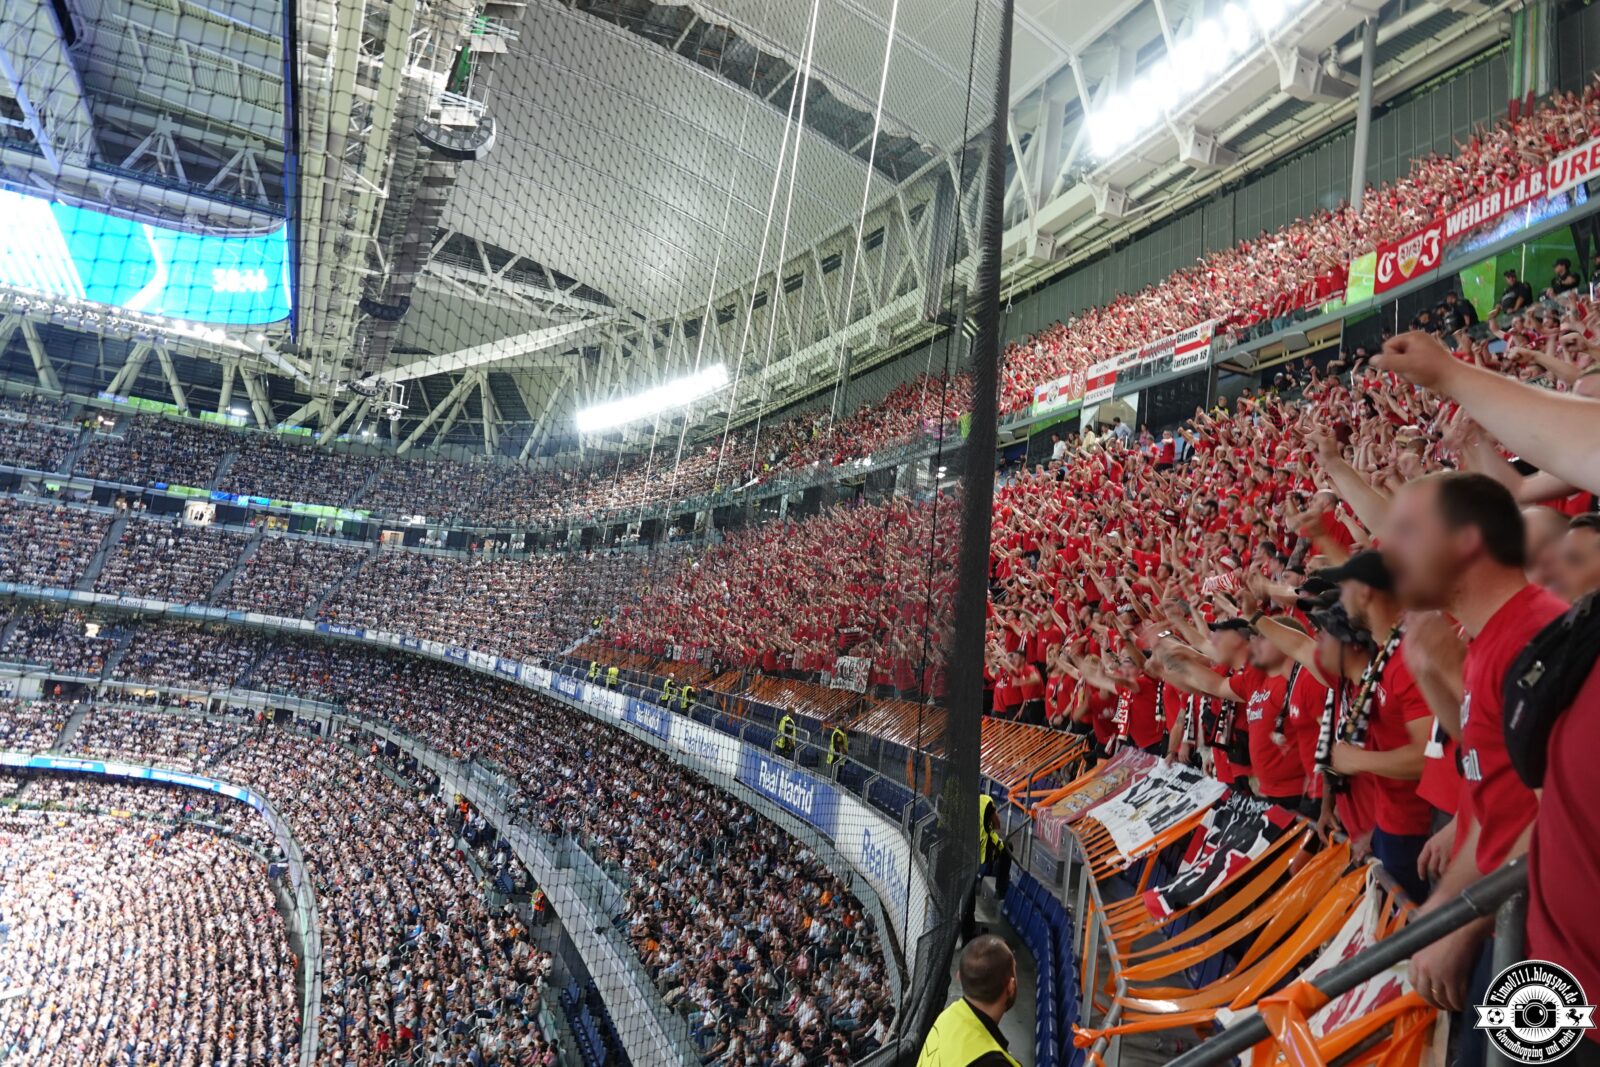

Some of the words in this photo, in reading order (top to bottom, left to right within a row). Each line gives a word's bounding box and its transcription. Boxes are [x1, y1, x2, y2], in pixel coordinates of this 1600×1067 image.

[1446, 189, 1501, 238] WEILER
[758, 761, 780, 792] Real
[778, 769, 815, 815] Madrid
[861, 827, 886, 879] Real
